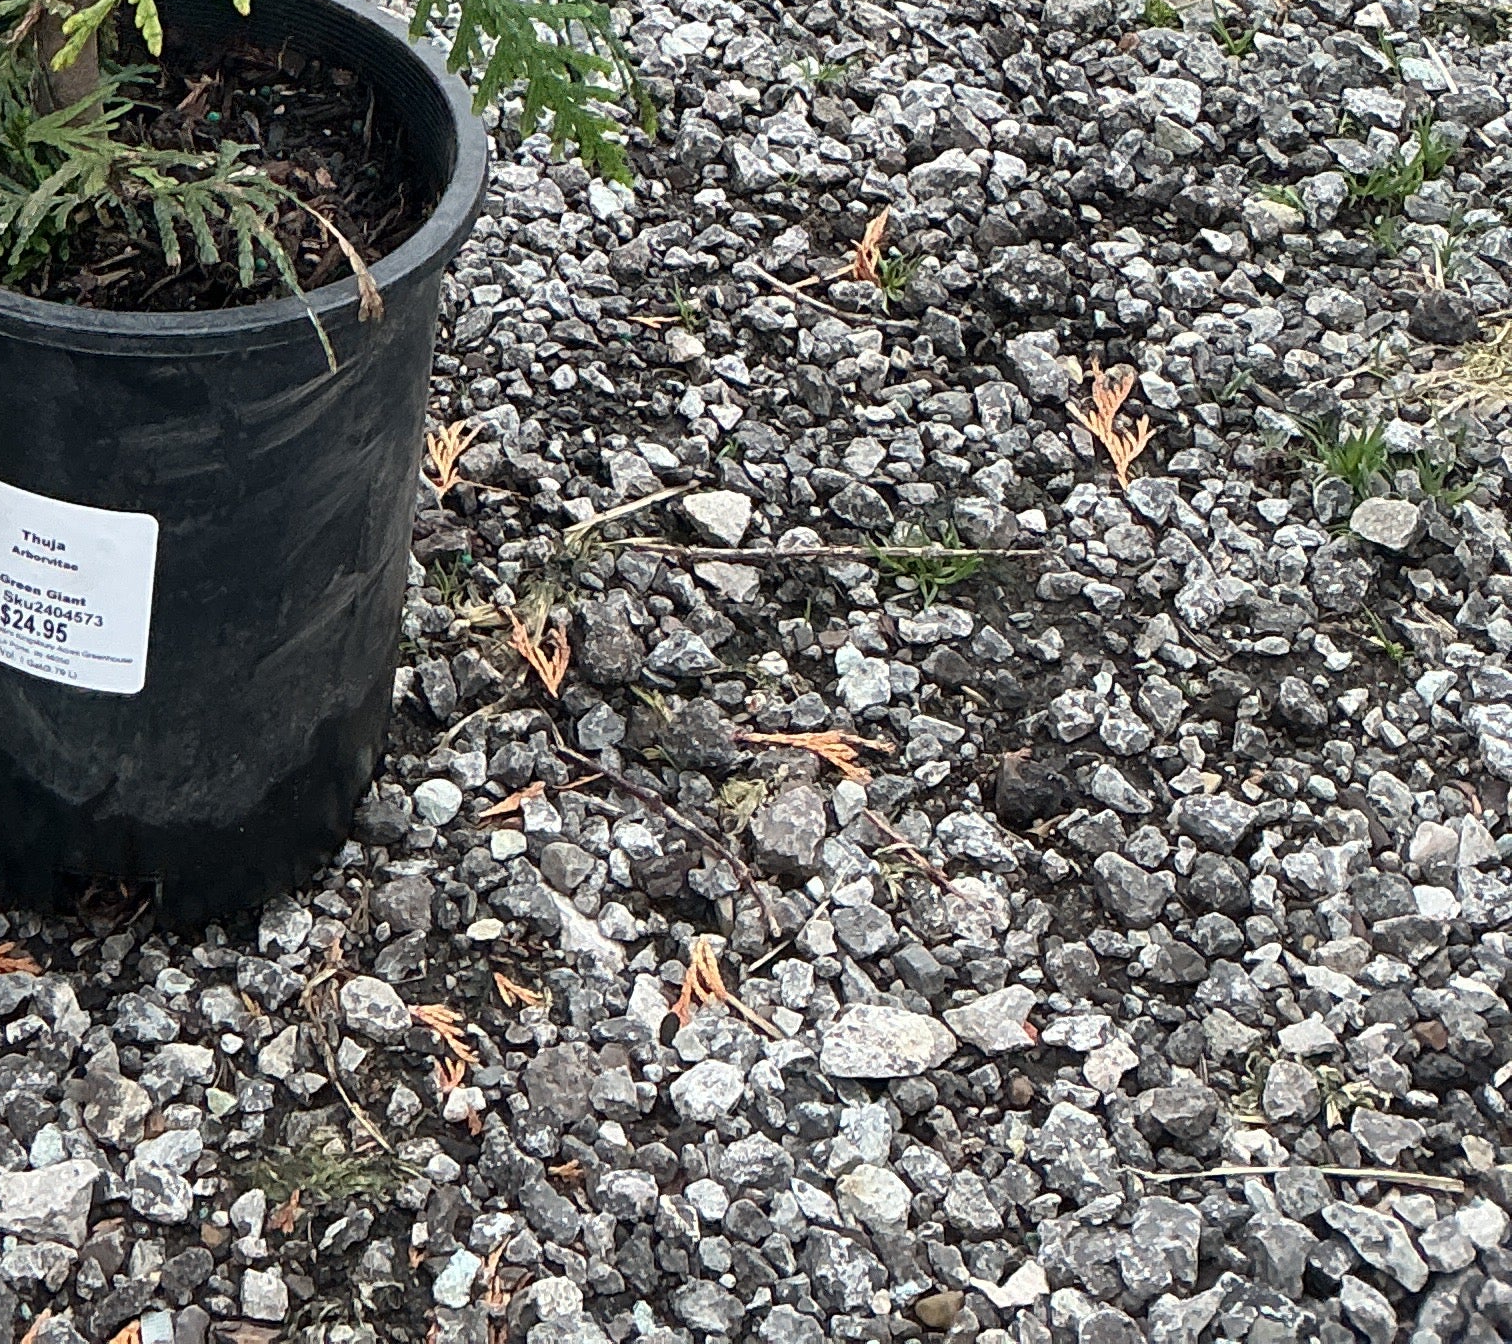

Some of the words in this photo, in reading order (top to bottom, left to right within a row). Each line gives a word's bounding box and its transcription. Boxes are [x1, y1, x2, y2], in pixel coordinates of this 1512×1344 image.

[21, 529, 66, 552] Thuja
[11, 545, 79, 571] Arborvitae
[0, 573, 41, 596] Green
[46, 589, 86, 607] Giant
[0, 603, 68, 643] $24.95
[3, 590, 104, 627] Sku2404573
